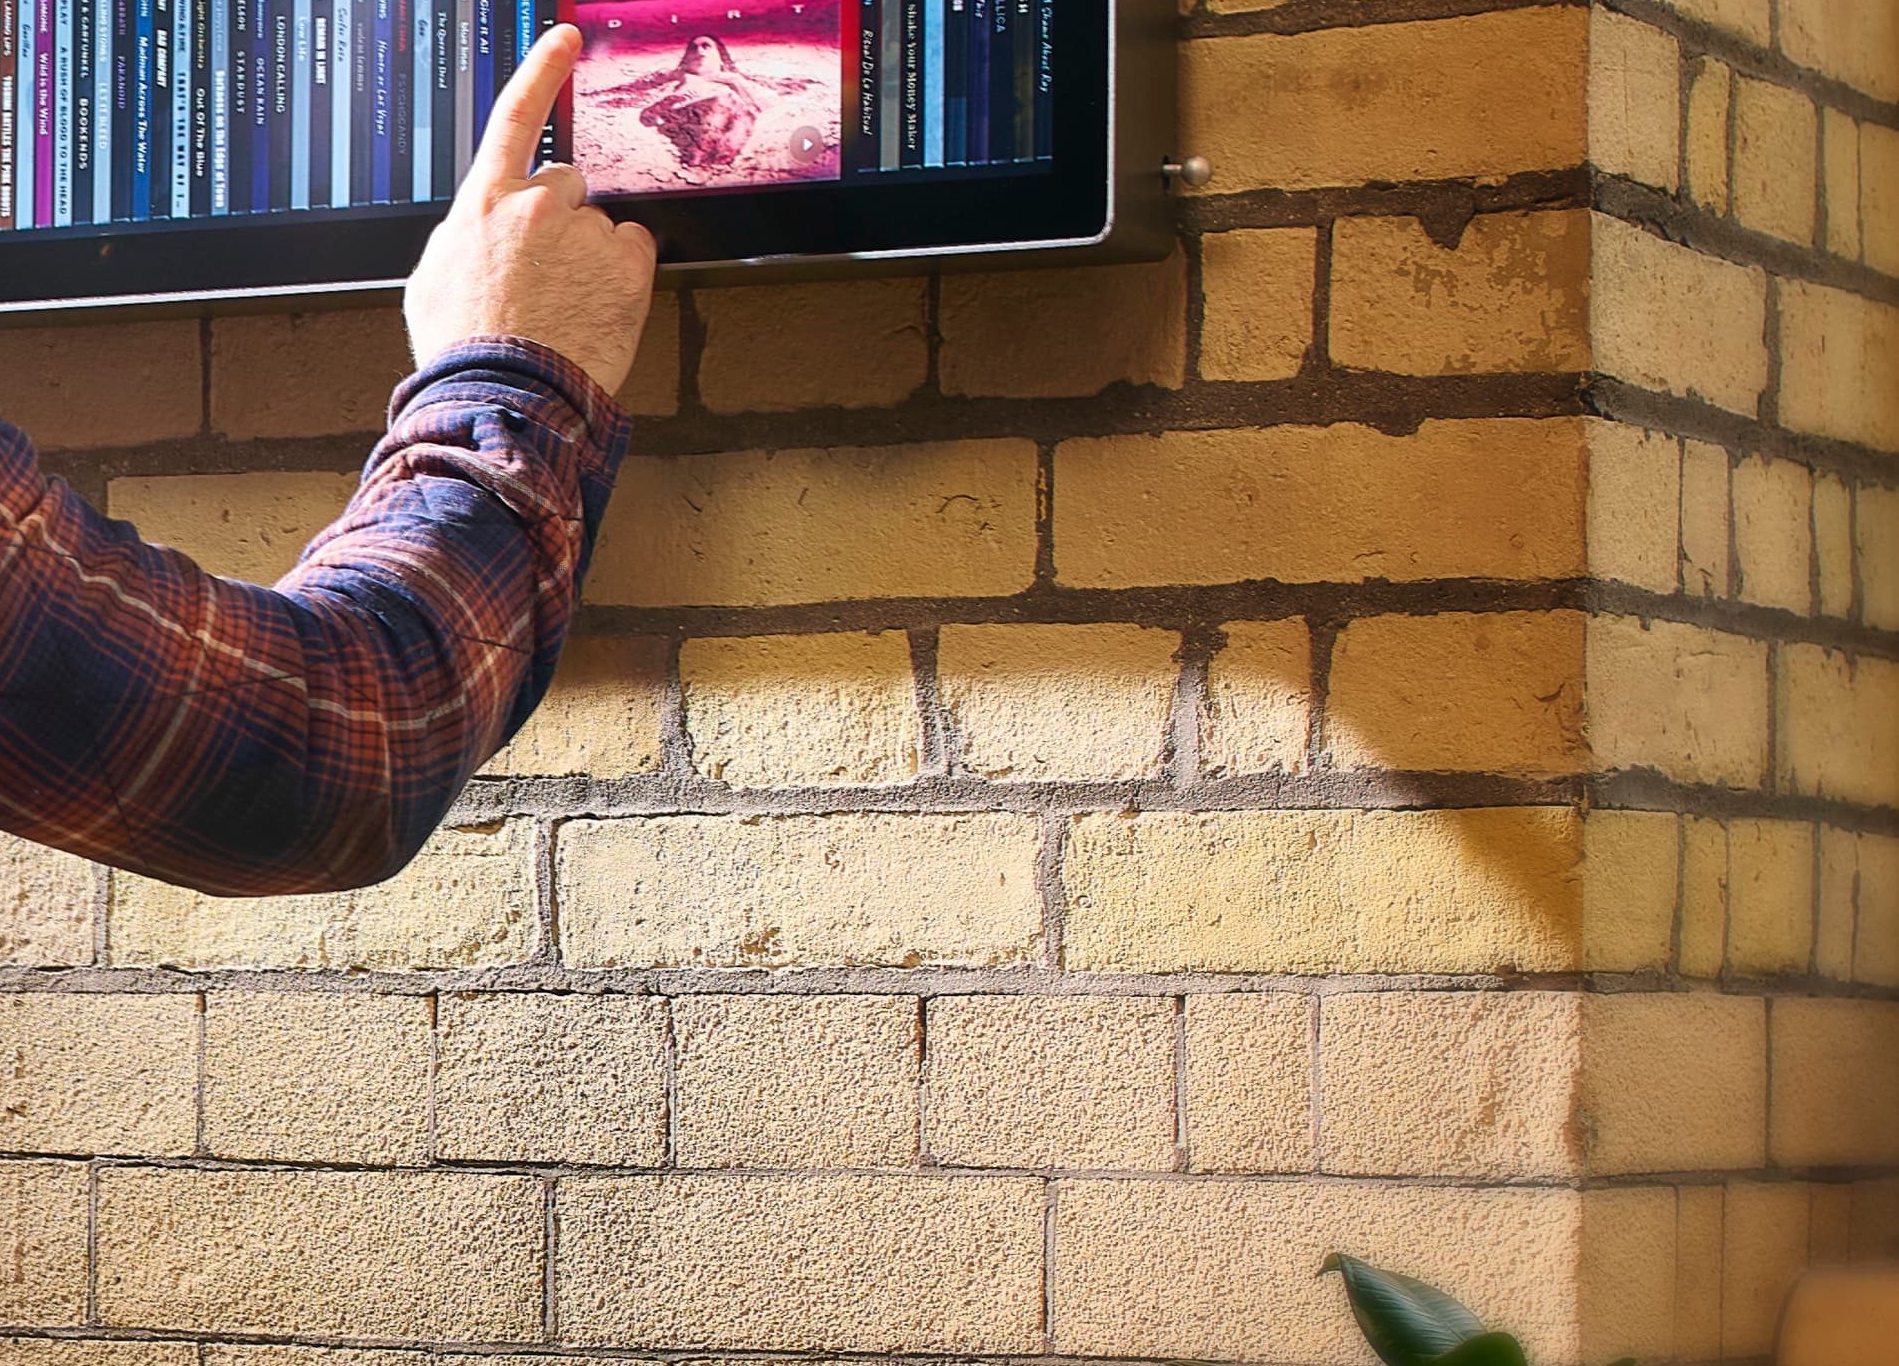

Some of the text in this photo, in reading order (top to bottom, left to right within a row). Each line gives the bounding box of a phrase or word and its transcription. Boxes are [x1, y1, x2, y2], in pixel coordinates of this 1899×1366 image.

[437, 11, 448, 28] The
[607, 4, 805, 29] DIRT
[4, 37, 12, 57] LIPS
[437, 29, 448, 56] Queen
[479, 37, 489, 55] All
[39, 52, 49, 77] Wild
[59, 57, 68, 86] RUSH
[156, 28, 168, 88] BAD COMPANY
[276, 16, 286, 114] LONDON CALLING
[236, 51, 246, 114] STARDUST
[437, 66, 448, 90] Dead
[906, 4, 918, 151] Shake Your Money Maker
[39, 88, 49, 106] the
[59, 88, 68, 103] OF
[138, 36, 149, 173] Madman Across The Water
[196, 87, 206, 109] Out
[256, 57, 265, 126] OCEAN RAIN
[39, 108, 49, 135] Wind
[59, 105, 68, 141] BLOOD
[79, 98, 89, 170] BOOKENDS
[196, 127, 206, 148] The
[59, 144, 68, 160] TO
[196, 150, 206, 177] Blue
[59, 162, 68, 183] THE
[59, 185, 68, 216] HEAD
